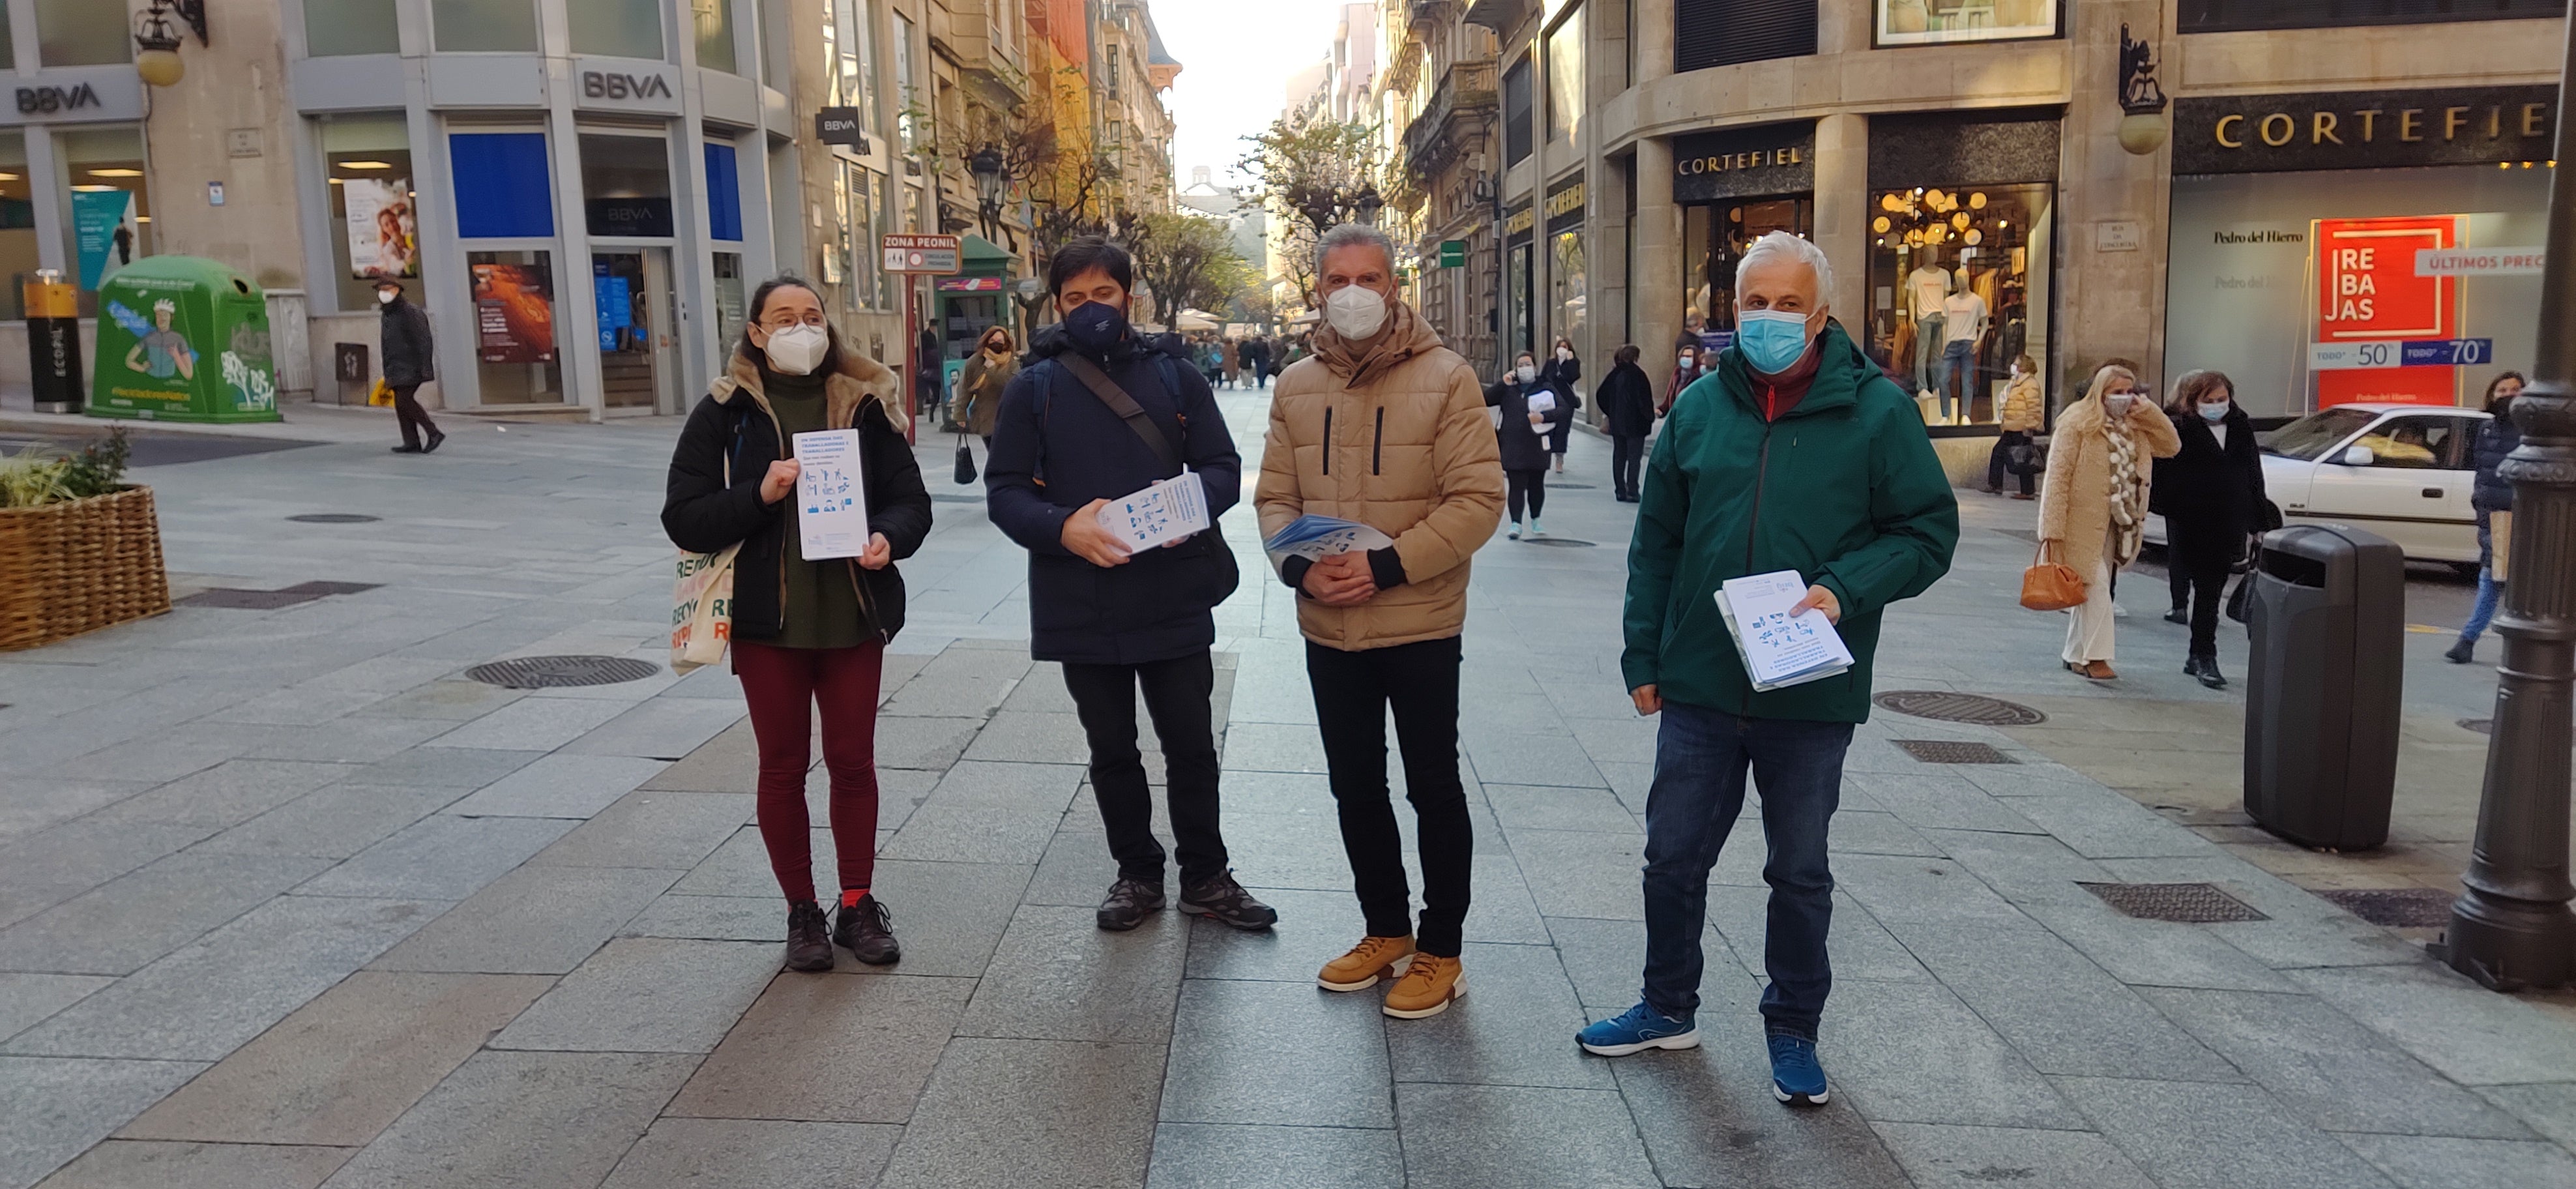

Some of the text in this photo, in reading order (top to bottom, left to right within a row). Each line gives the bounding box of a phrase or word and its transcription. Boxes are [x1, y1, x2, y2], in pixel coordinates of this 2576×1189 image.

[583, 71, 672, 99] BBVA
[16, 81, 101, 114] BBVA
[824, 119, 855, 130] BBVA
[2216, 103, 2546, 148] CORTEFIE
[1678, 147, 1803, 175] CORTEFIEL
[608, 207, 652, 222] BBVA
[885, 237, 956, 248] ZONA PEONIL
[2214, 231, 2304, 244] Pedro del Hierro
[2429, 254, 2544, 269] ÚLTIMOS PREC
